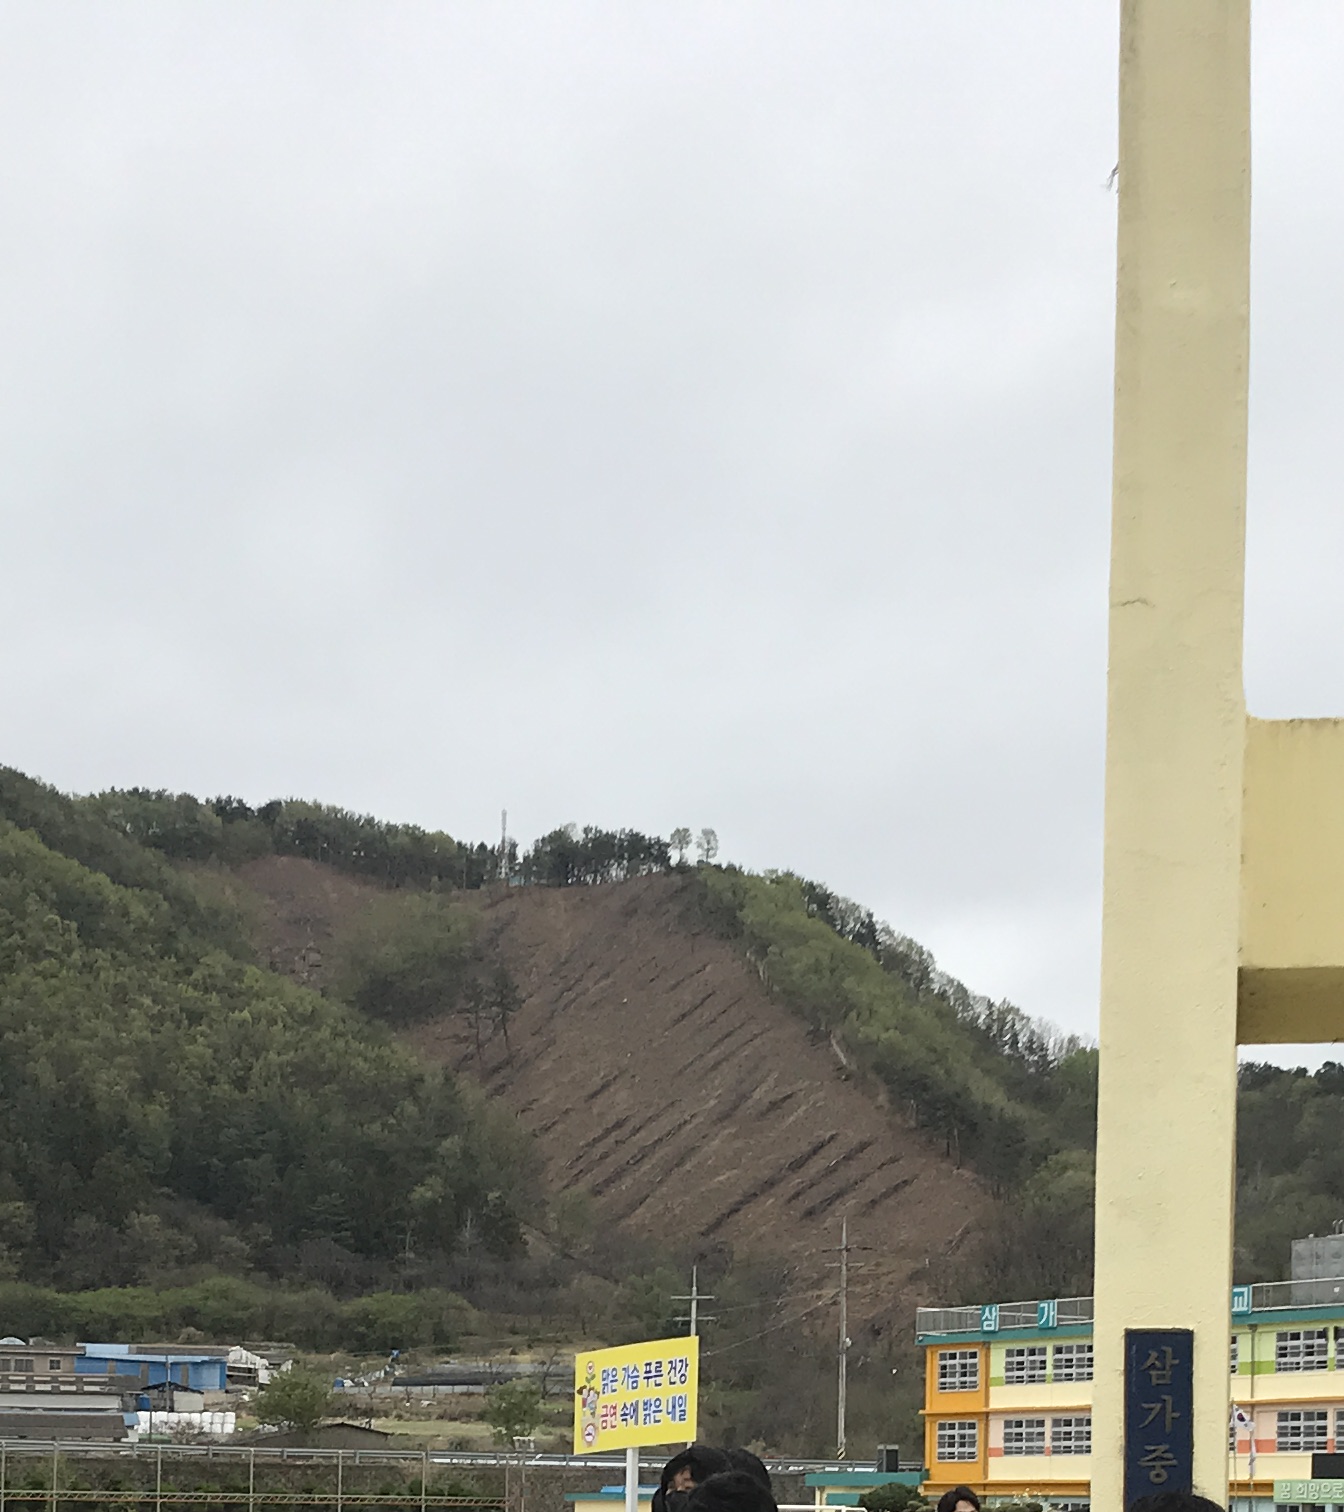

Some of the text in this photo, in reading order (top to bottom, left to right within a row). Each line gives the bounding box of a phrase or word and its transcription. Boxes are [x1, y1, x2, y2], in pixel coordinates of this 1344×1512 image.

[601, 1357, 689, 1395] 맑은 가슴 푸른 건강
[601, 1394, 687, 1430] 금연 속에 밝은 내일
